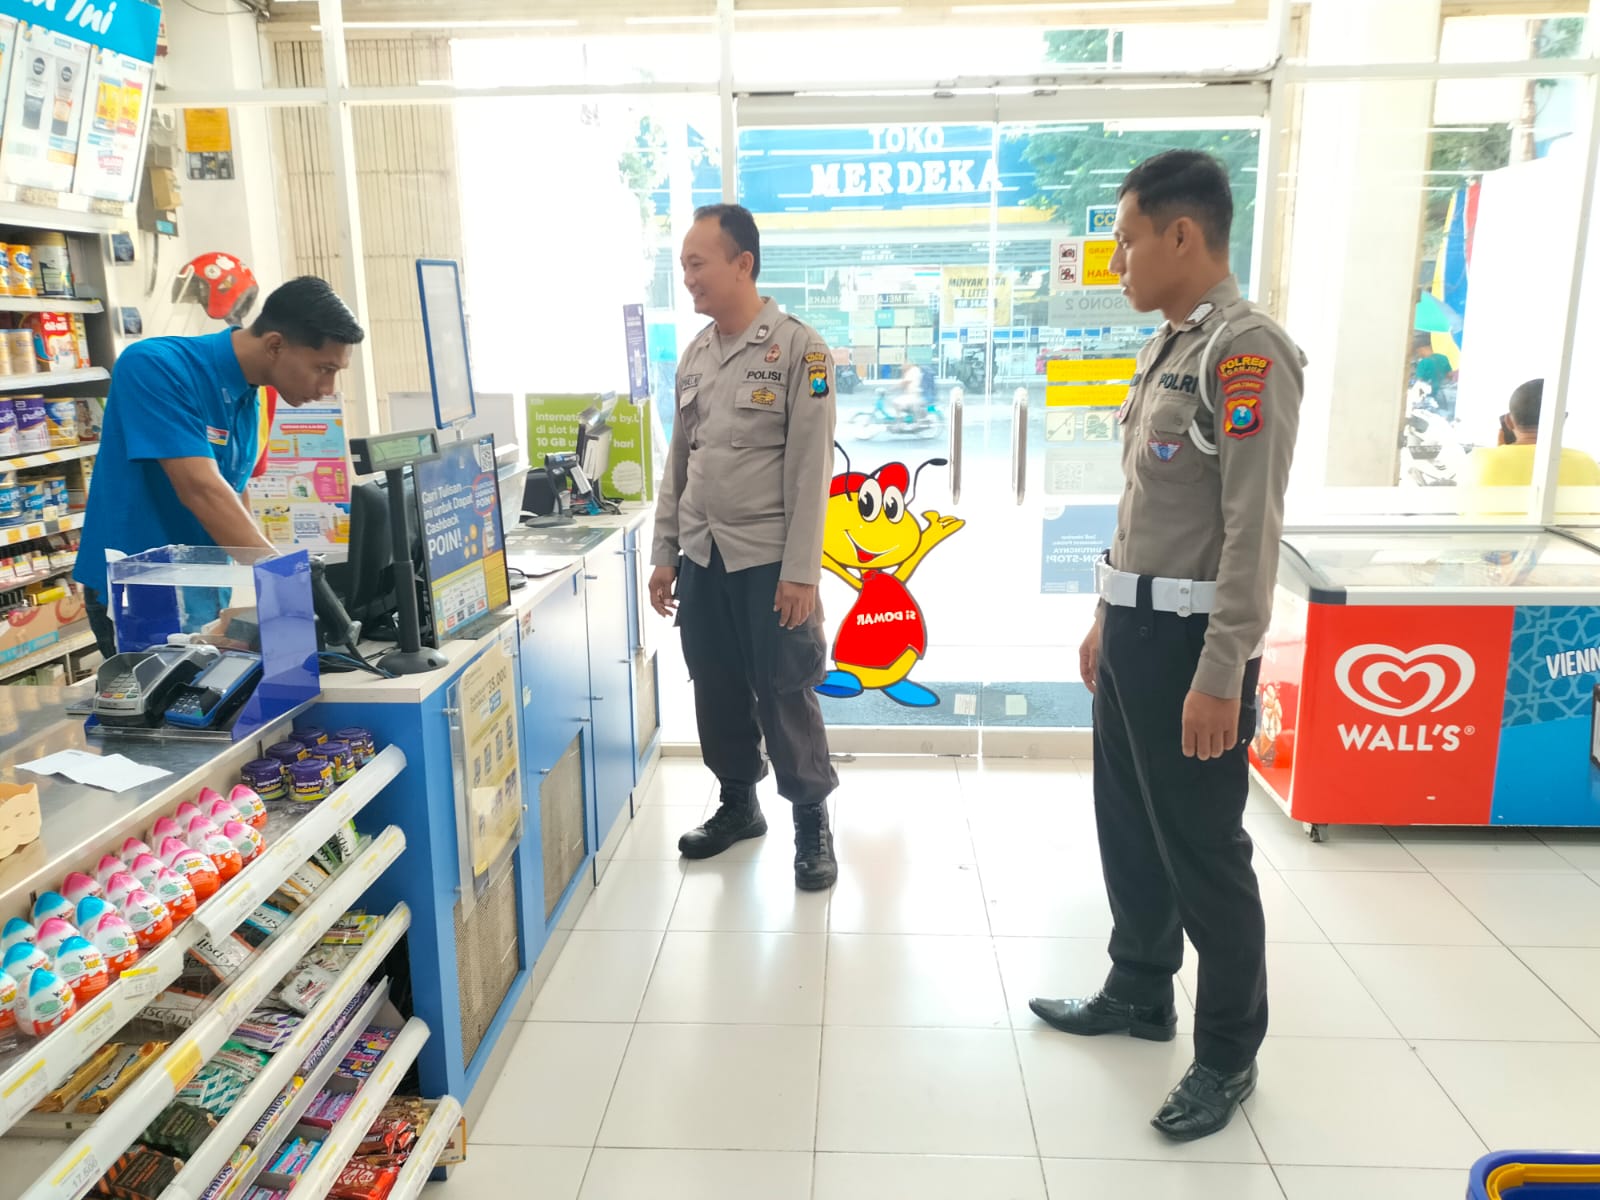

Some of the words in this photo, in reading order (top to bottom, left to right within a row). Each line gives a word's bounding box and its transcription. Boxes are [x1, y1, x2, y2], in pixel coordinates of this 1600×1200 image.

[869, 125, 945, 152] TOKO
[810, 159, 1002, 195] MERDEKA
[746, 371, 782, 381] POLISI
[1219, 356, 1268, 374] POLRES
[1159, 373, 1199, 394] POLRI
[536, 437, 547, 447] 10
[550, 437, 566, 447] GB
[614, 439, 634, 448] hari
[428, 528, 463, 560] POIN!
[1337, 724, 1461, 751] WALL'S
[255, 1095, 287, 1133] mentos
[201, 1165, 233, 1200] entos
